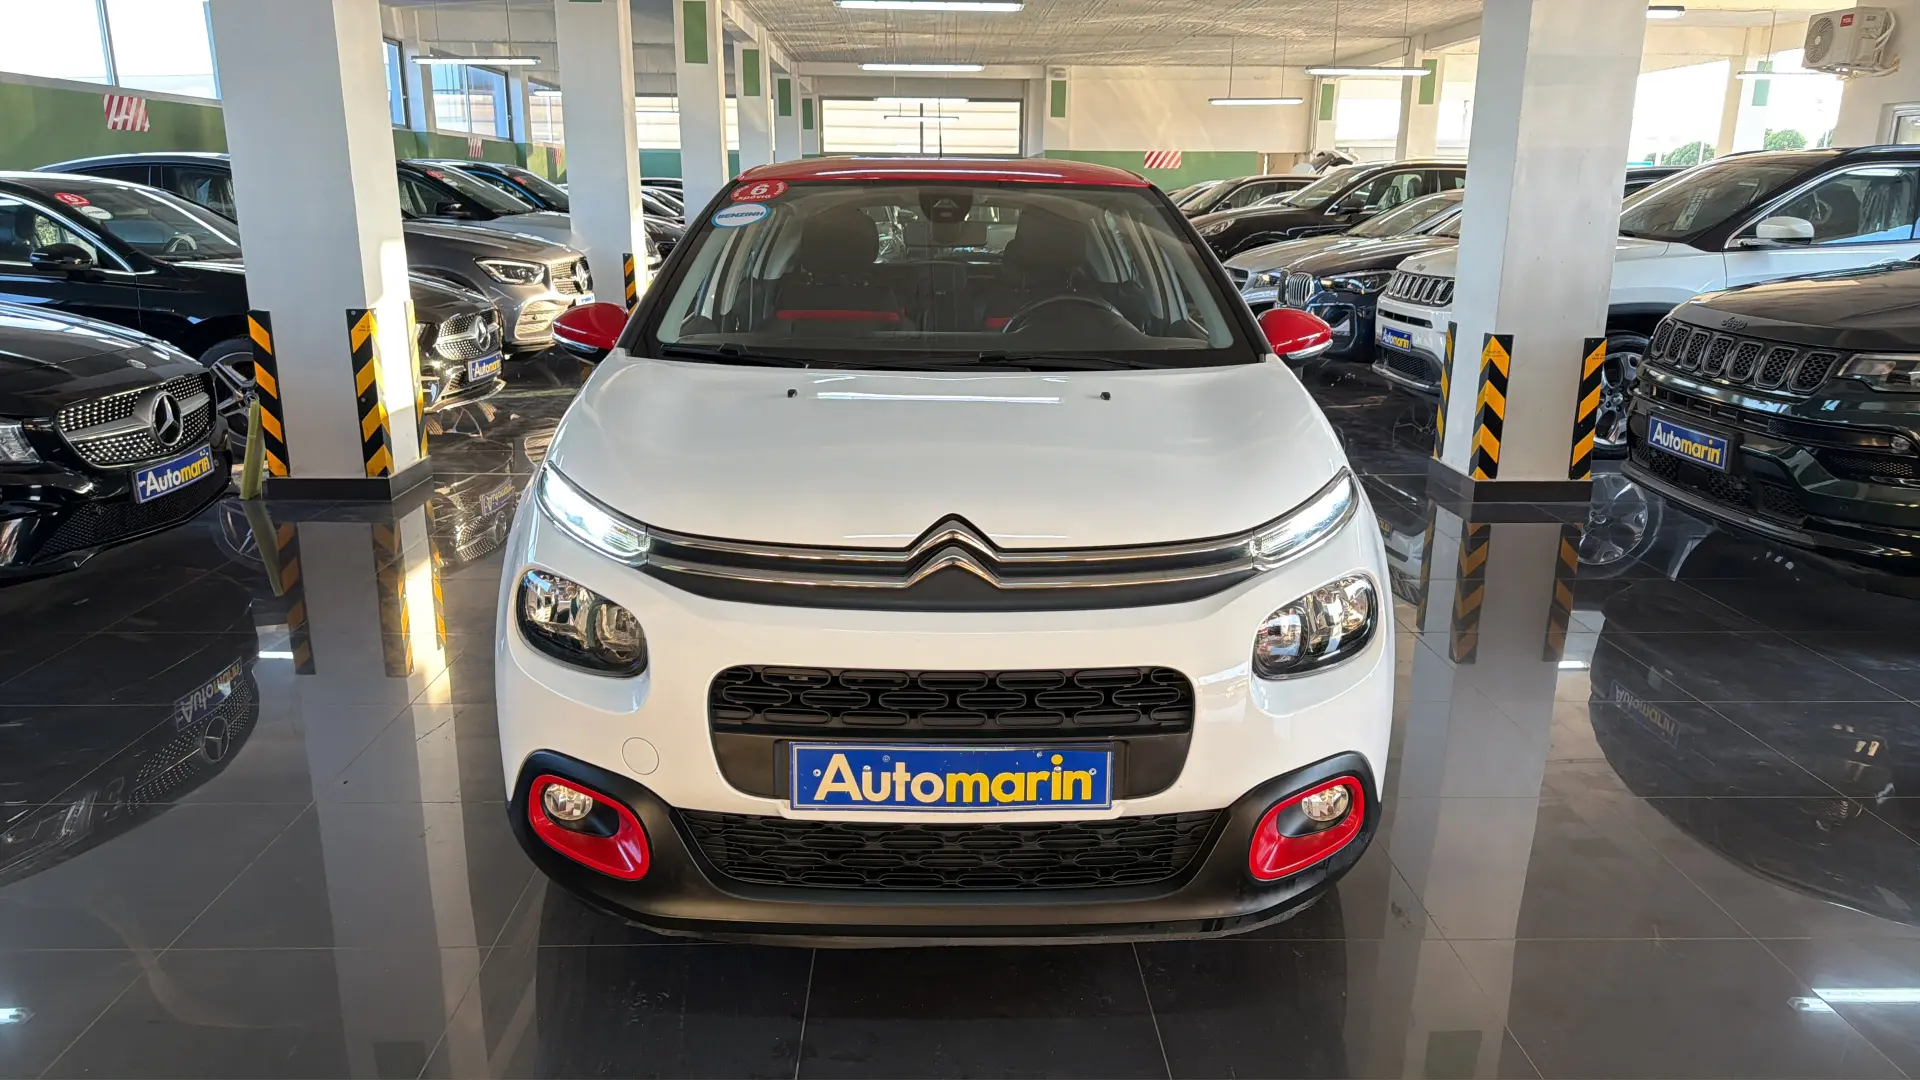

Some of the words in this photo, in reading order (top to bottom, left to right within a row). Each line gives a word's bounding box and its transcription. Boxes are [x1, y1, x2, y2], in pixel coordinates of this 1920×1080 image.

[750, 184, 770, 195] 6
[1653, 422, 1721, 465] Automarin
[146, 451, 211, 497] Automarin
[813, 753, 1092, 803] Automarin
